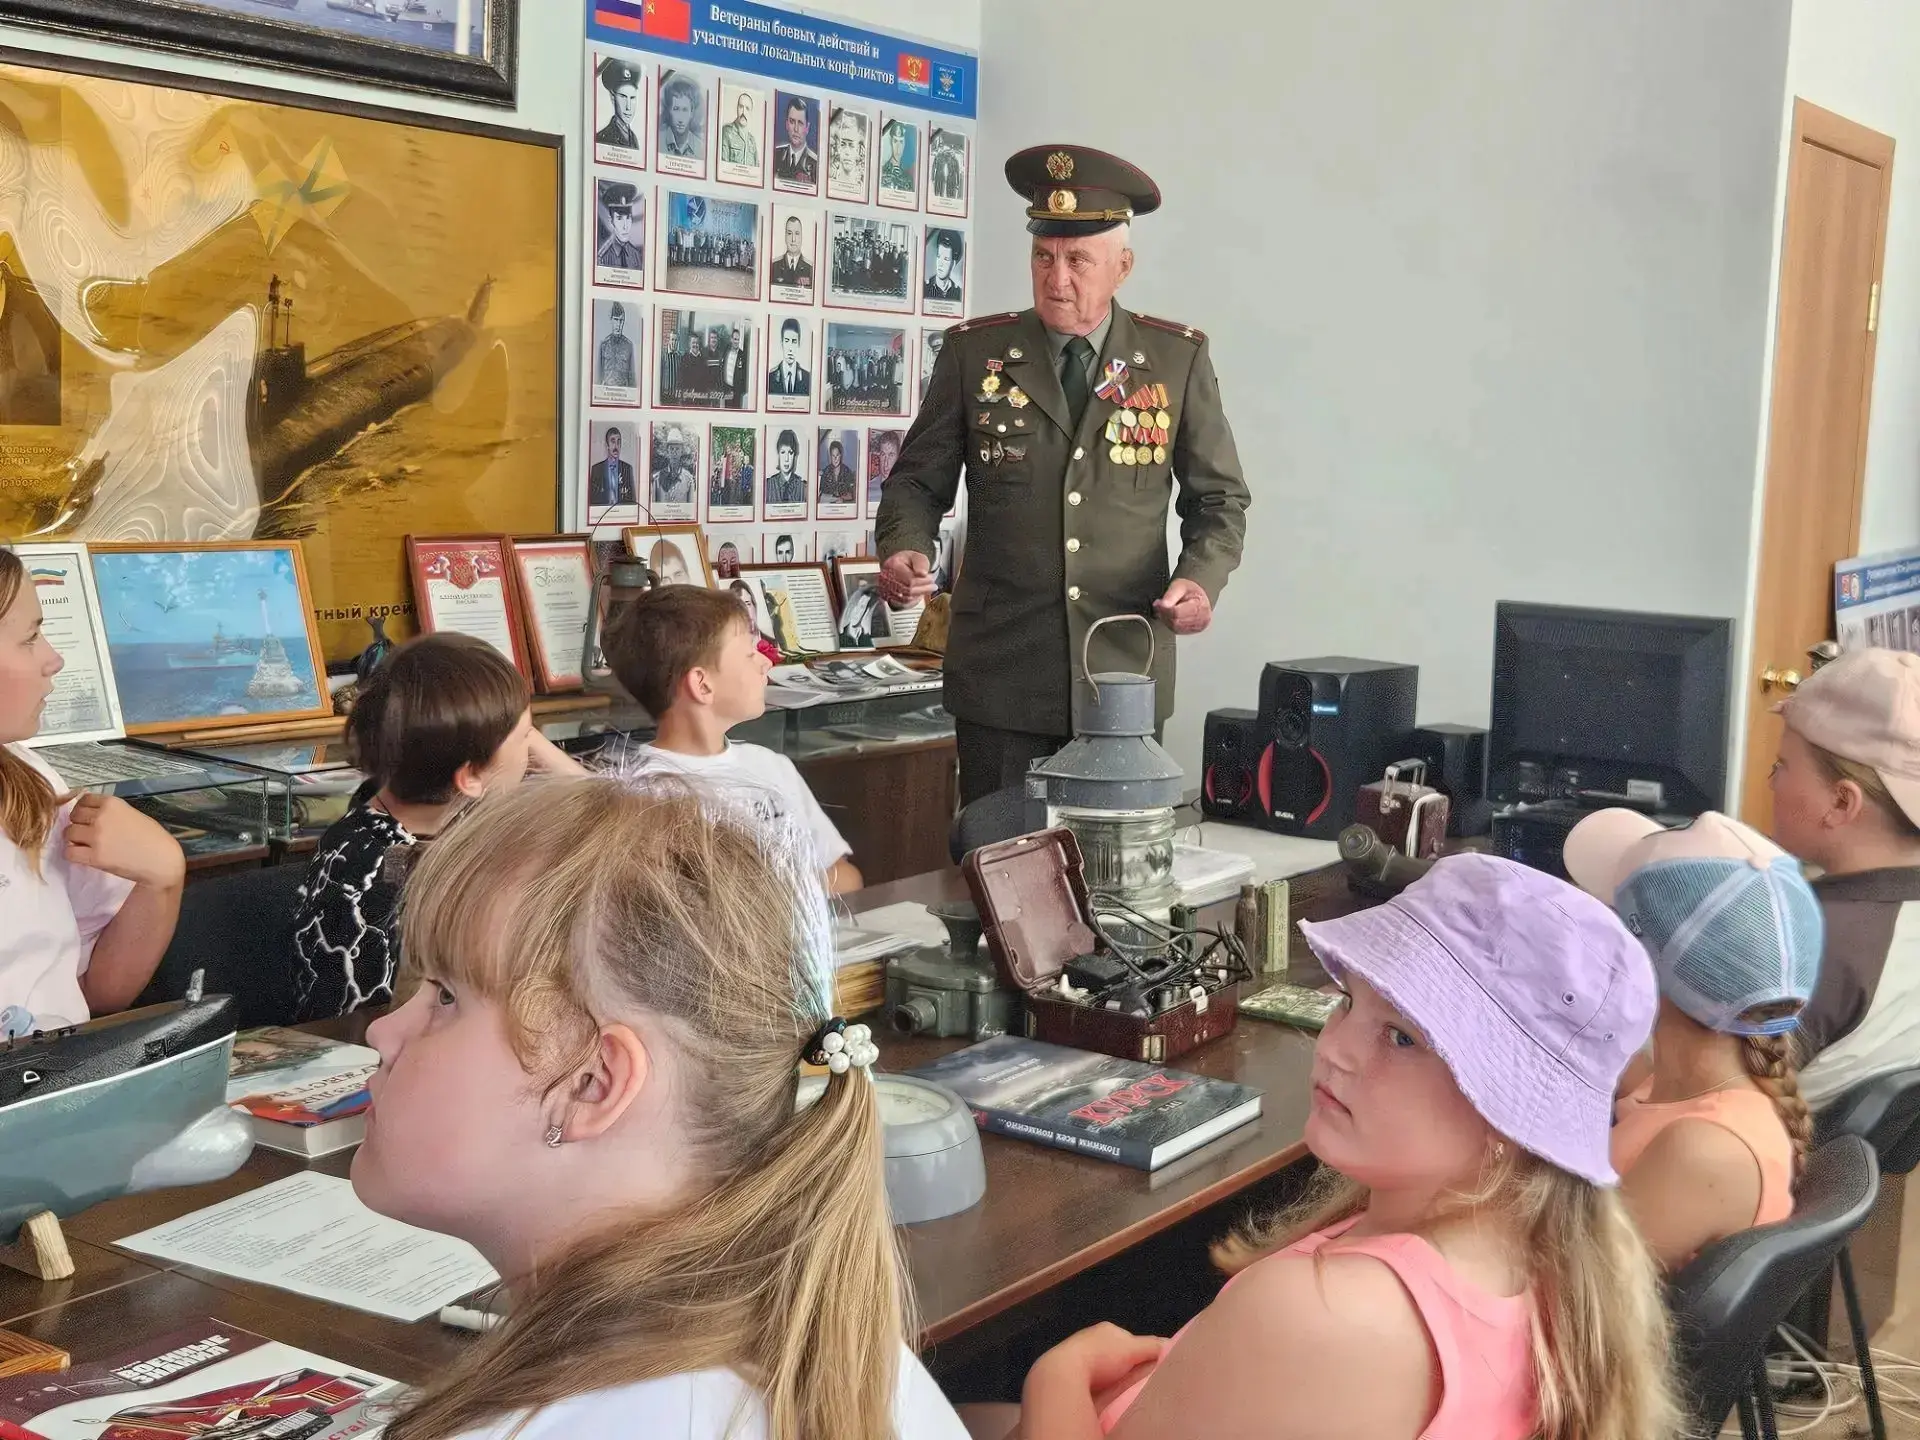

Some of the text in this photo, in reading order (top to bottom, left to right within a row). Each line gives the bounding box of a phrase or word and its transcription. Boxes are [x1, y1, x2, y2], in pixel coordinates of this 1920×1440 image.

[711, 4, 880, 59] Ветераны боевых действий и
[692, 29, 895, 85] участники локальных конфликтов
[1068, 1073, 1194, 1128] КУРСК
[1079, 1137, 1121, 1156] Помним
[117, 1334, 230, 1379] ВОЕННЫЕ
[130, 1345, 230, 1384] ЗНАНИЯ
